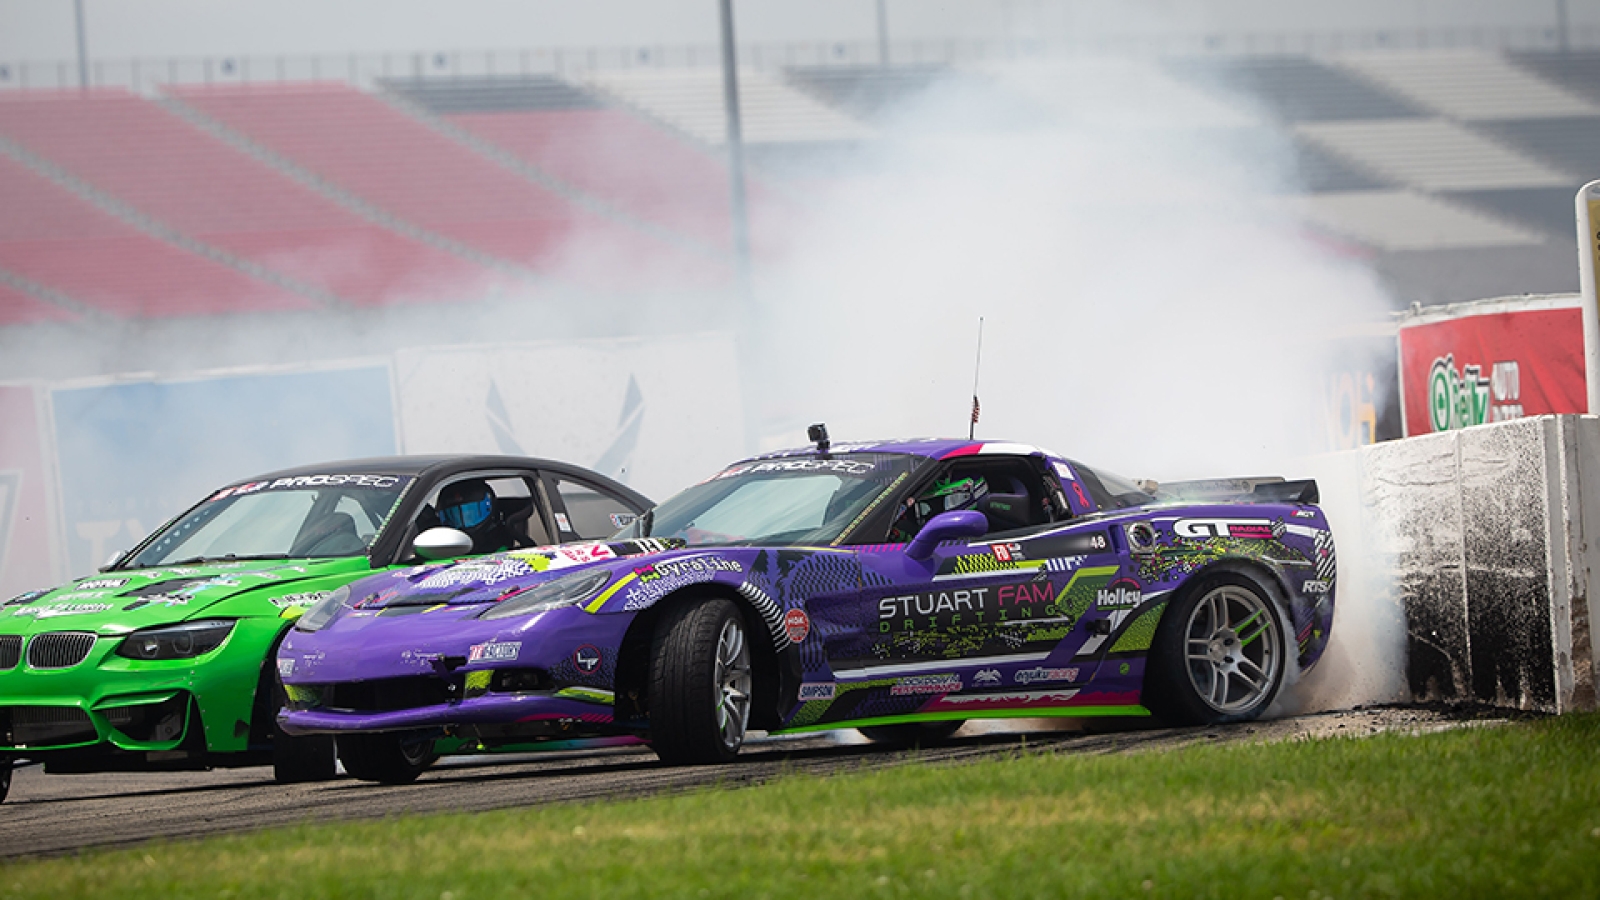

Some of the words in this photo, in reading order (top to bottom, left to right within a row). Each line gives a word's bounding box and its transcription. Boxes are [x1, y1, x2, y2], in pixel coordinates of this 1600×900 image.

[270, 474, 399, 489] PROSPEC
[1090, 535, 1106, 549] 48
[879, 588, 988, 619] STUART
[998, 581, 1054, 605] FAM
[1097, 588, 1141, 608] Holley
[880, 604, 1056, 633] DRIFTING
[800, 685, 834, 699] SIMPSON
